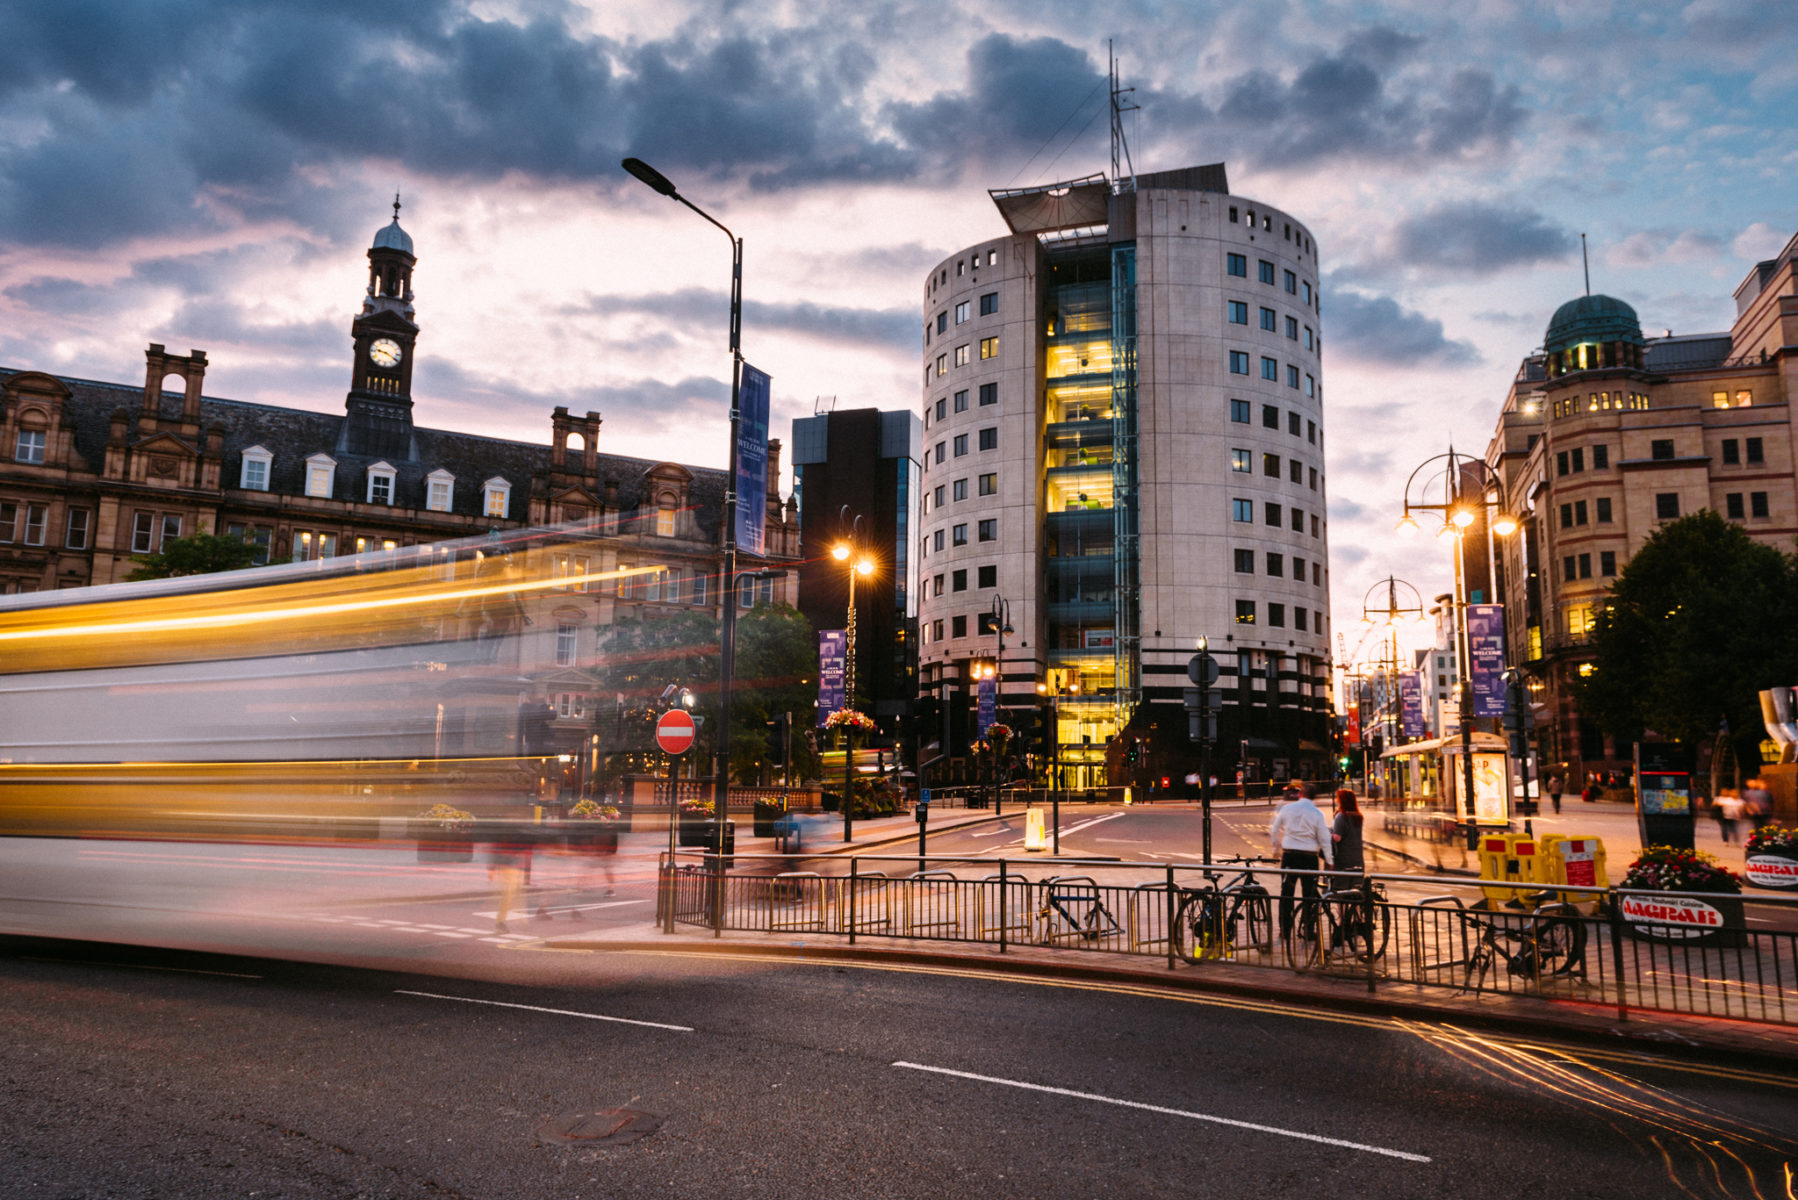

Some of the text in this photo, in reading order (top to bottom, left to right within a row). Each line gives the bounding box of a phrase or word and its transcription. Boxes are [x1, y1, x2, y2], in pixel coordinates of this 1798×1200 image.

[738, 439, 766, 456] WELCOME
[1680, 899, 1704, 908] Cuisine
[1624, 901, 1718, 925] AAGRAH
